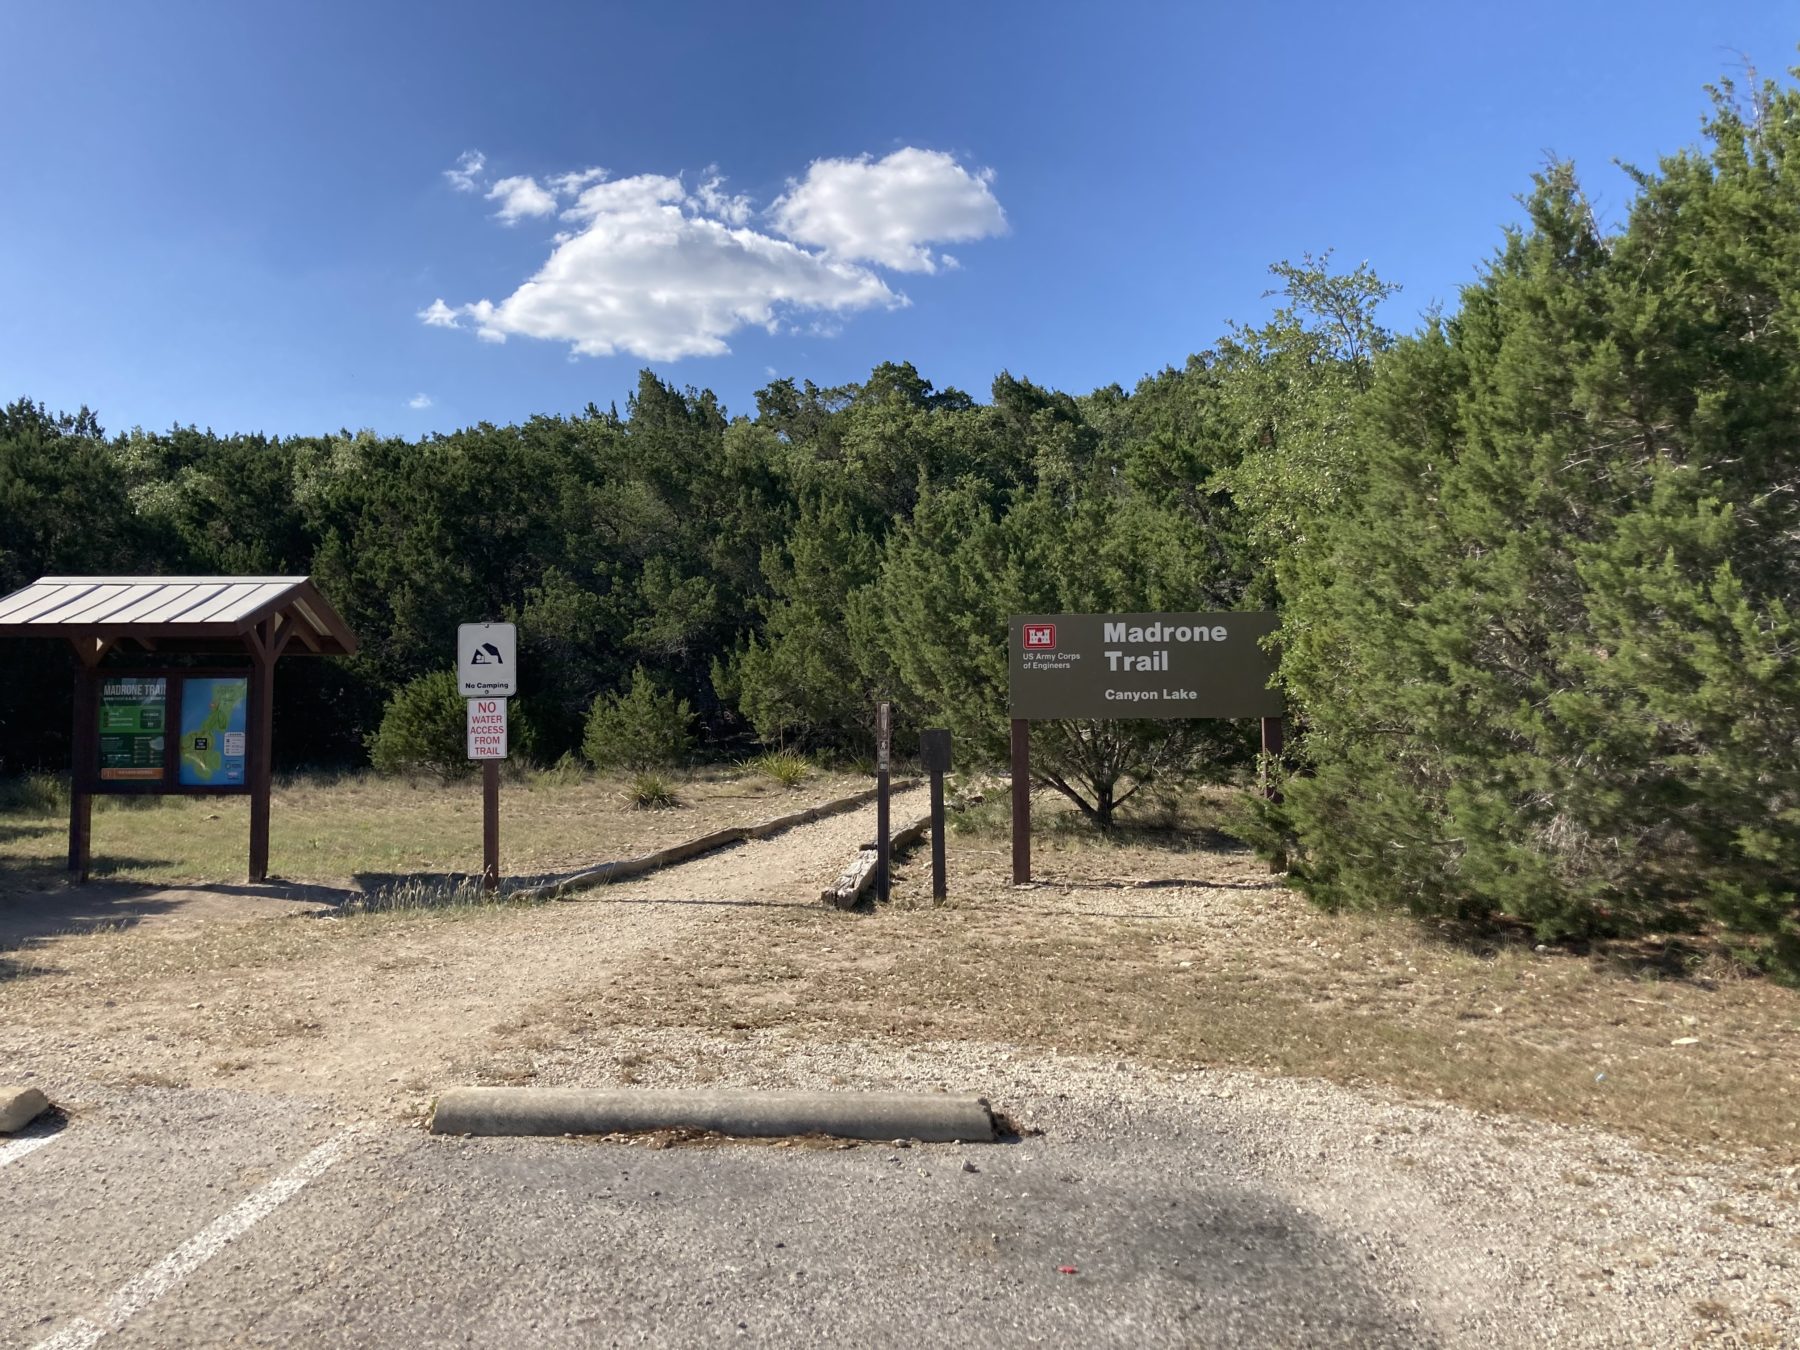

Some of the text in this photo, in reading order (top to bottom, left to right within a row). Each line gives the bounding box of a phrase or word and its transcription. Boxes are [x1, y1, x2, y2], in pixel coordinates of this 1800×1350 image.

[1103, 622, 1228, 643] Madrone
[1035, 653, 1056, 661] Army
[1057, 652, 1081, 661] Corps
[1104, 650, 1169, 671] Trail
[1032, 662, 1071, 671] Engineers
[103, 684, 143, 696] MADRONE
[476, 682, 509, 690] Camping
[1105, 689, 1198, 701] Canyon Lake
[478, 701, 497, 713] NO
[472, 715, 503, 724] WATER
[470, 726, 505, 734] ACCESS
[474, 736, 500, 745] FROM
[475, 747, 501, 755] TRAIL
